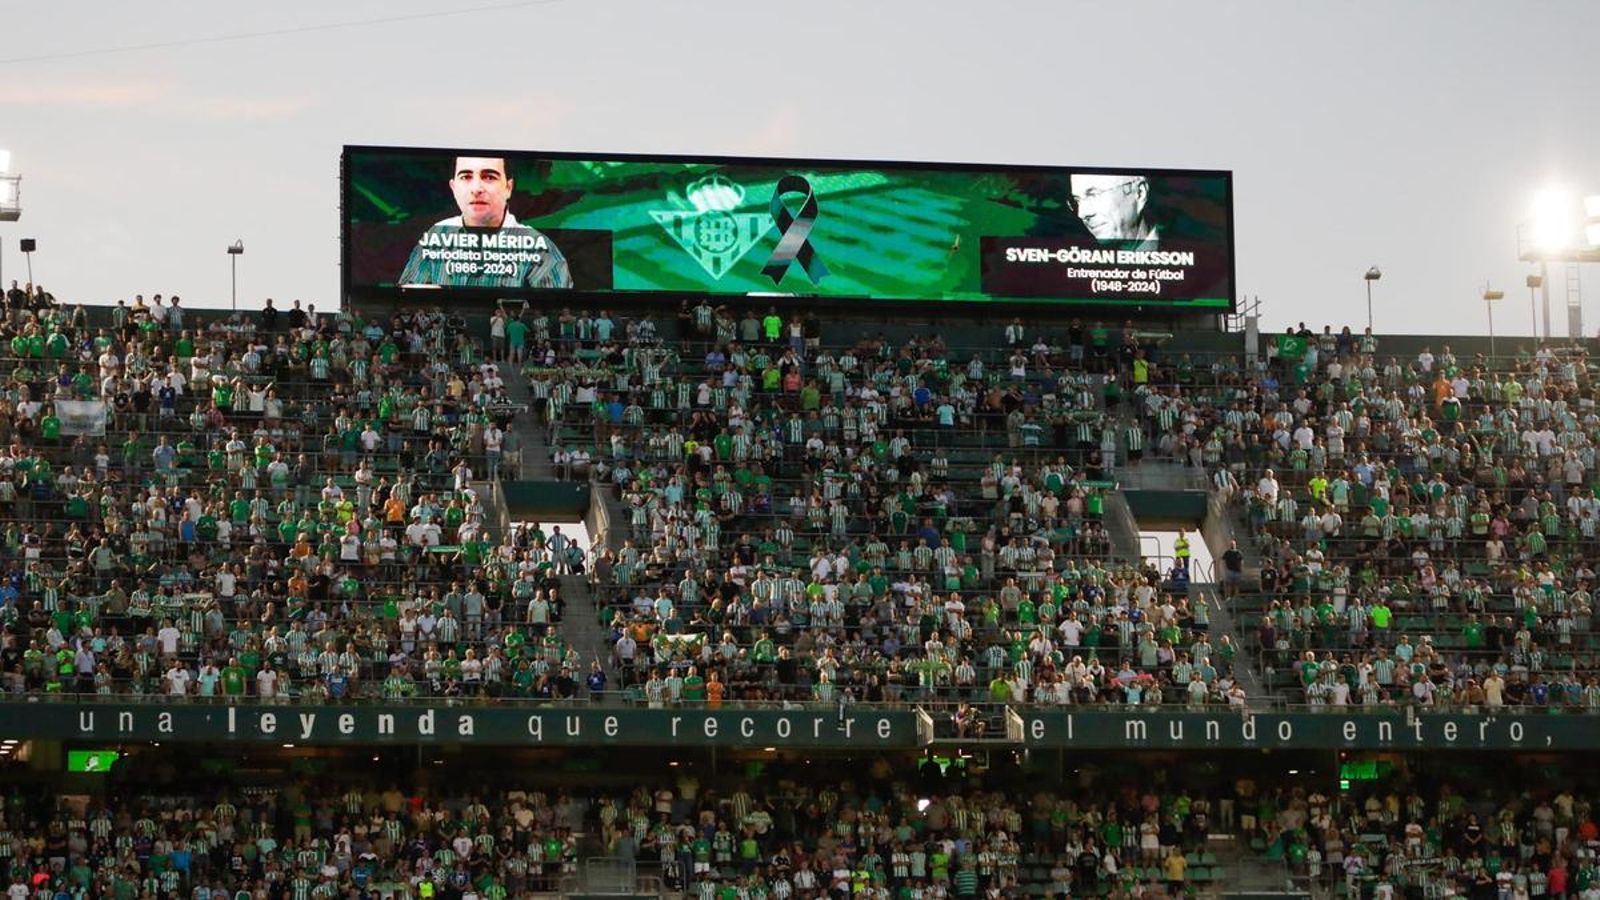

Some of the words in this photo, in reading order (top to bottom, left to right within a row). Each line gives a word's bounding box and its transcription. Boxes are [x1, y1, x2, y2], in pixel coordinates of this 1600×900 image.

[419, 232, 479, 247] JAVIER
[482, 231, 548, 249] MÉRIDA
[422, 249, 482, 261] Periodista
[483, 251, 541, 264] Deportivo
[1006, 246, 1115, 263] SVEN-GÖRAN
[1116, 250, 1194, 266] ERIKSSON
[445, 262, 518, 275] (1966-2024)
[1066, 267, 1130, 280] Entrenador
[1131, 269, 1147, 280] de
[1149, 269, 1184, 281] Fútbol
[1091, 279, 1161, 294] (1948-2024)
[79, 711, 173, 732] una
[228, 708, 474, 739] leyenda
[528, 714, 618, 742] que
[672, 716, 890, 738] recorre
[1031, 713, 1074, 740] el
[1125, 716, 1292, 741] mundo
